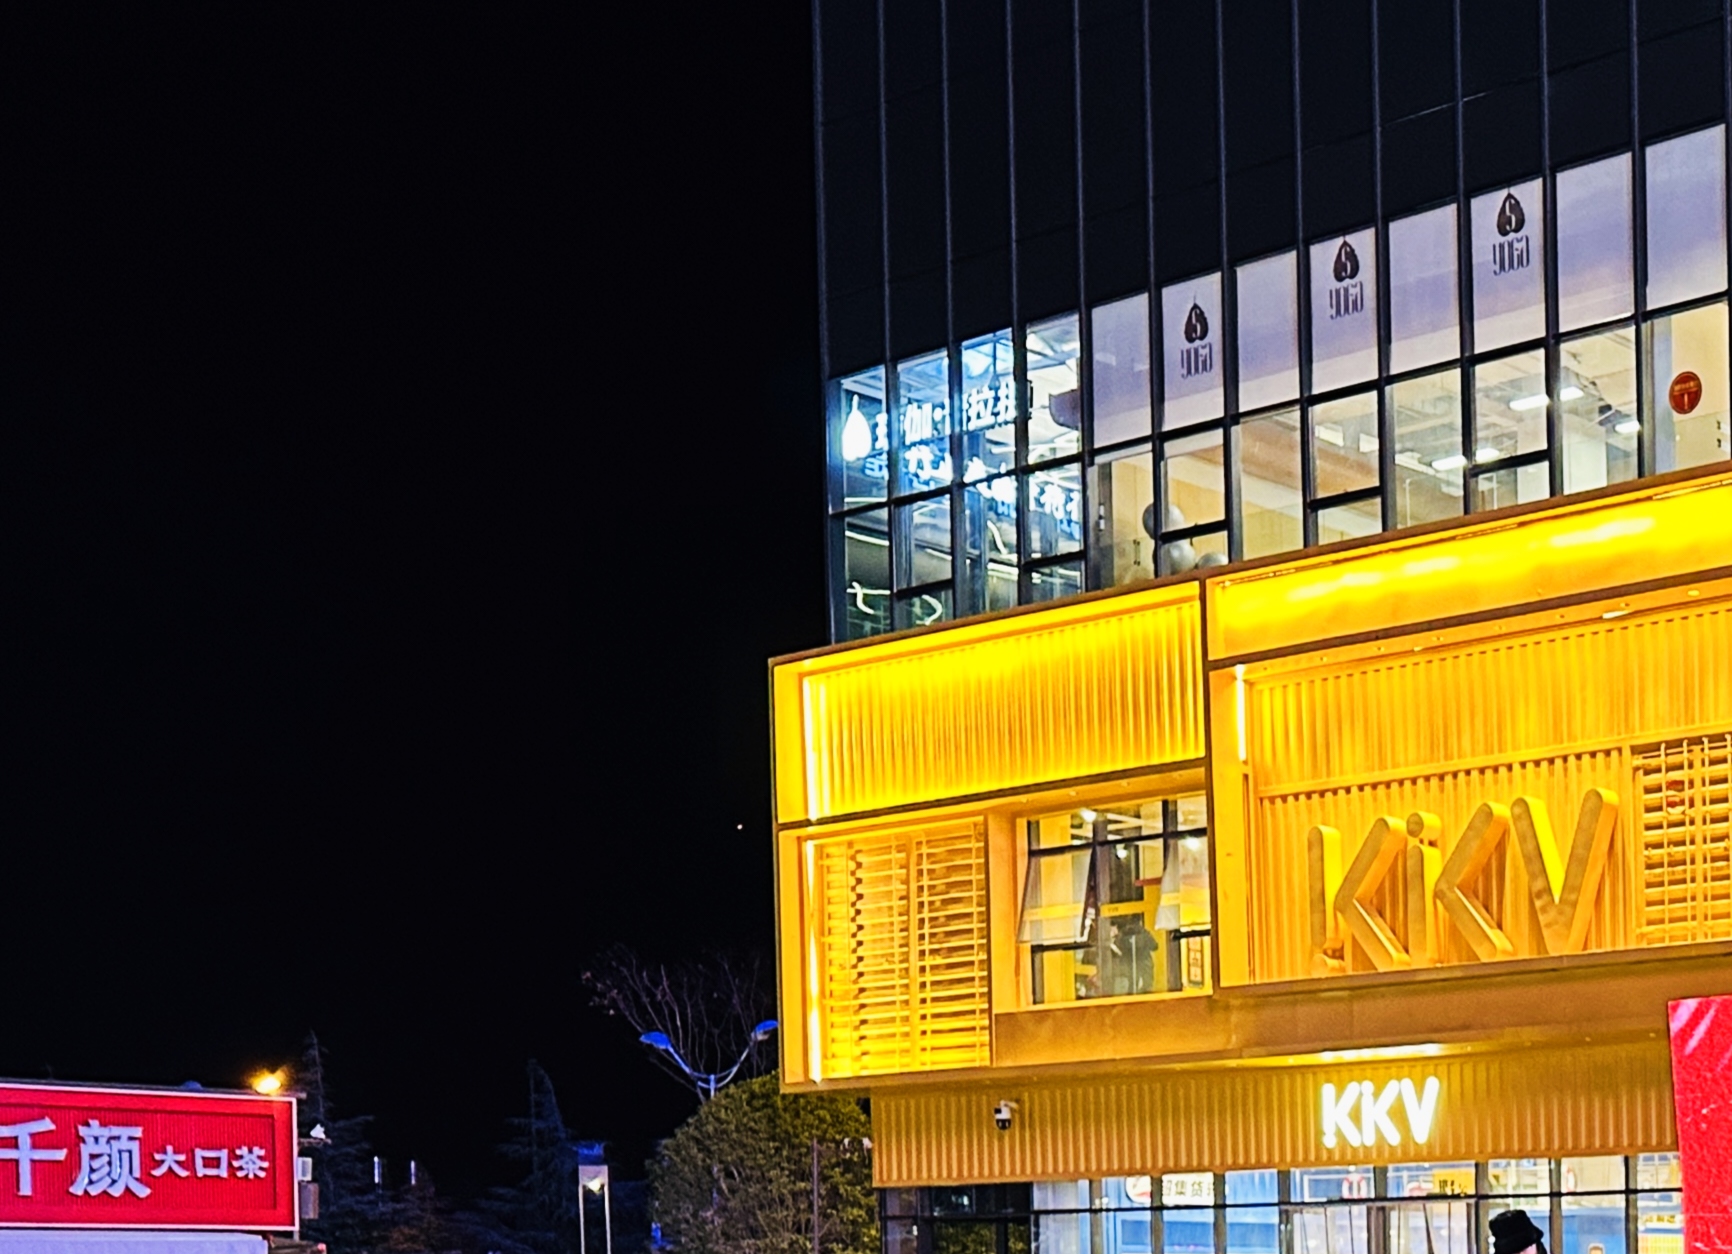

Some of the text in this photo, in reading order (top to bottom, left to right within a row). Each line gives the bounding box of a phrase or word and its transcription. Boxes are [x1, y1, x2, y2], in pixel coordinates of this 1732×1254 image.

[1321, 1075, 1440, 1149] KKV
[0, 1115, 269, 1199] 千颜 大口茶
